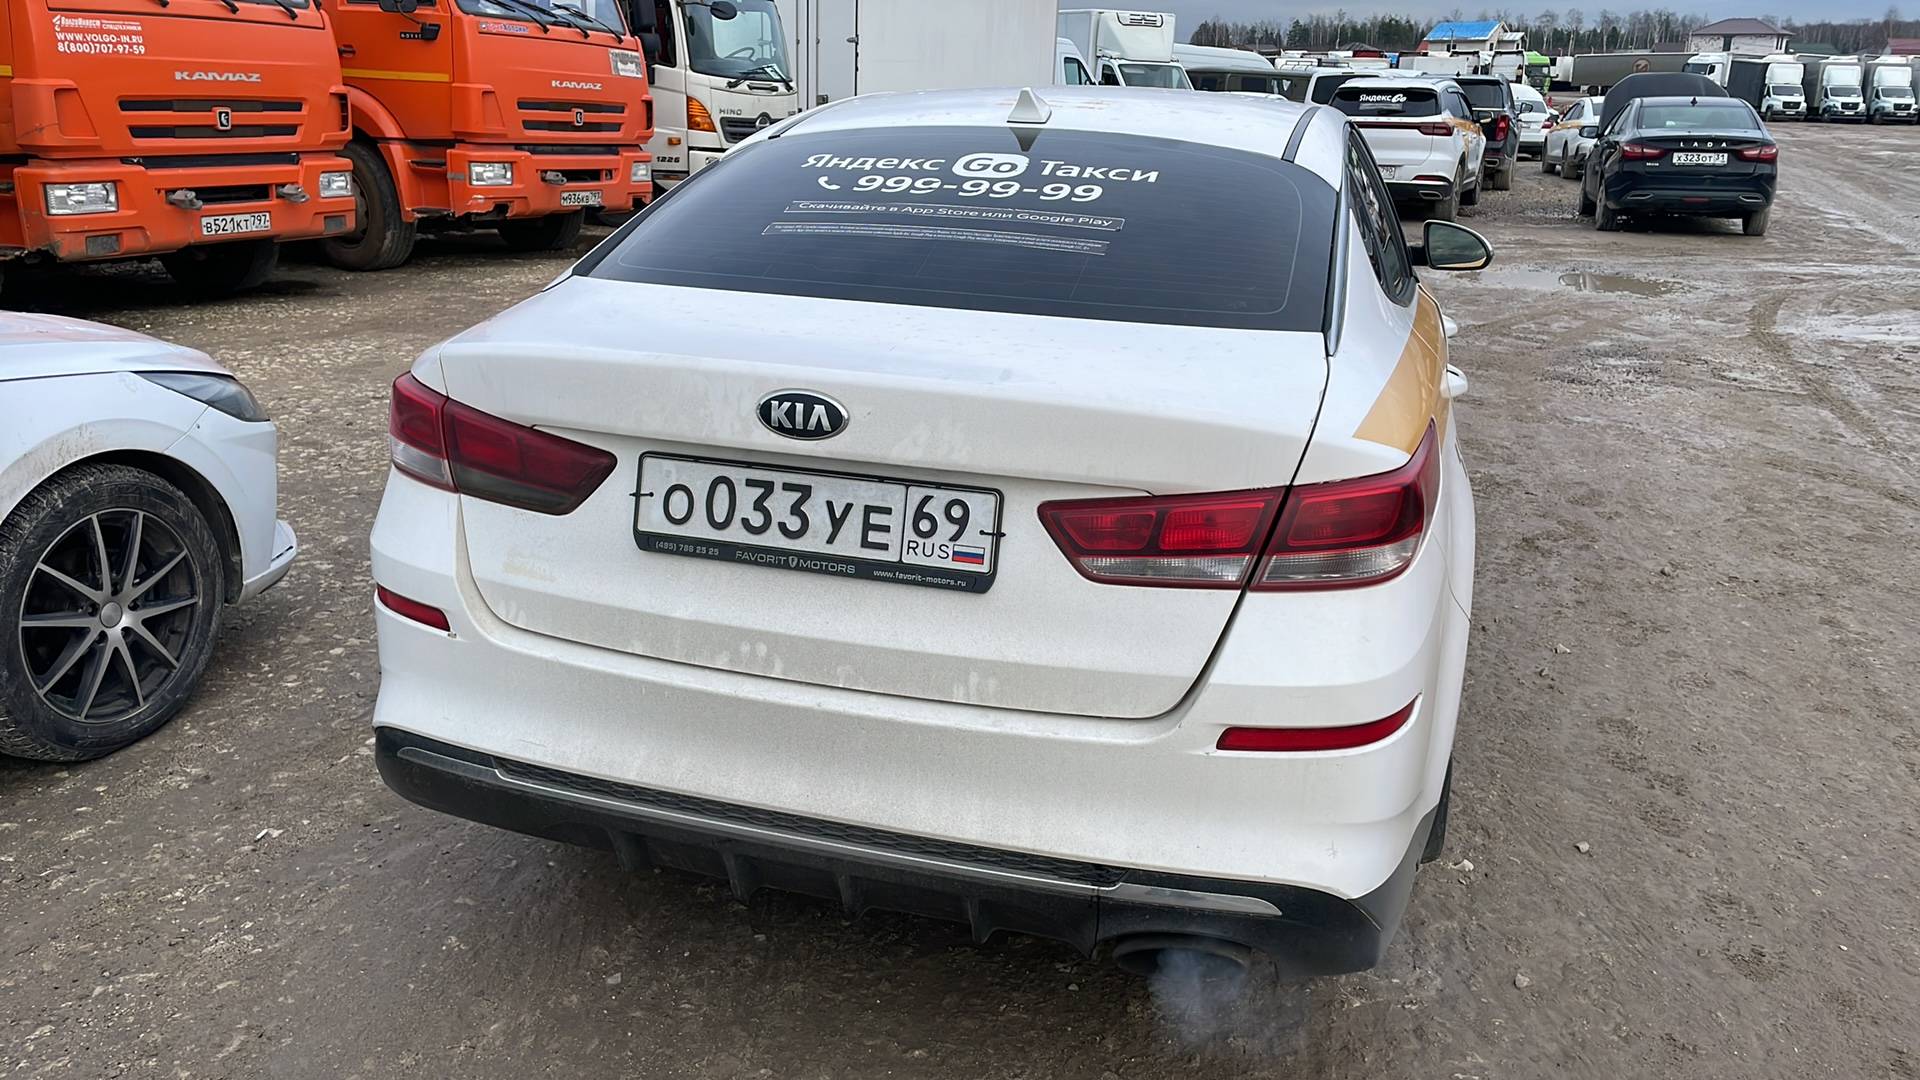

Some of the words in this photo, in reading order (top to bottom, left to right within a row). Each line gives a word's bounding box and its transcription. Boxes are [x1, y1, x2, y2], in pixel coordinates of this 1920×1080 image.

[55, 32, 143, 43] WWW.VOLGO-IN.RU
[57, 41, 145, 54] 8(800)707-97-59
[175, 71, 262, 82] KAMAZ
[551, 80, 602, 90] KAMAZ
[1360, 94, 1392, 102] Яндекс
[1391, 93, 1407, 103] Go
[719, 108, 742, 116] HINO
[801, 153, 946, 171] Яндекс
[1040, 160, 1160, 183] Такси
[852, 175, 1103, 202] 999-99-99
[799, 202, 886, 212] Скачивайте
[902, 206, 934, 215] App
[936, 208, 979, 216] Store
[982, 211, 1012, 219] или
[1016, 212, 1074, 224] Google
[1078, 214, 1113, 227] Play
[770, 400, 832, 432] KIA
[912, 495, 970, 542] 69
[906, 540, 949, 559] RUS
[735, 550, 788, 566] FAVORIT
[799, 559, 856, 574] MOTORS
[873, 569, 967, 587] www.favorit-motors.ru
